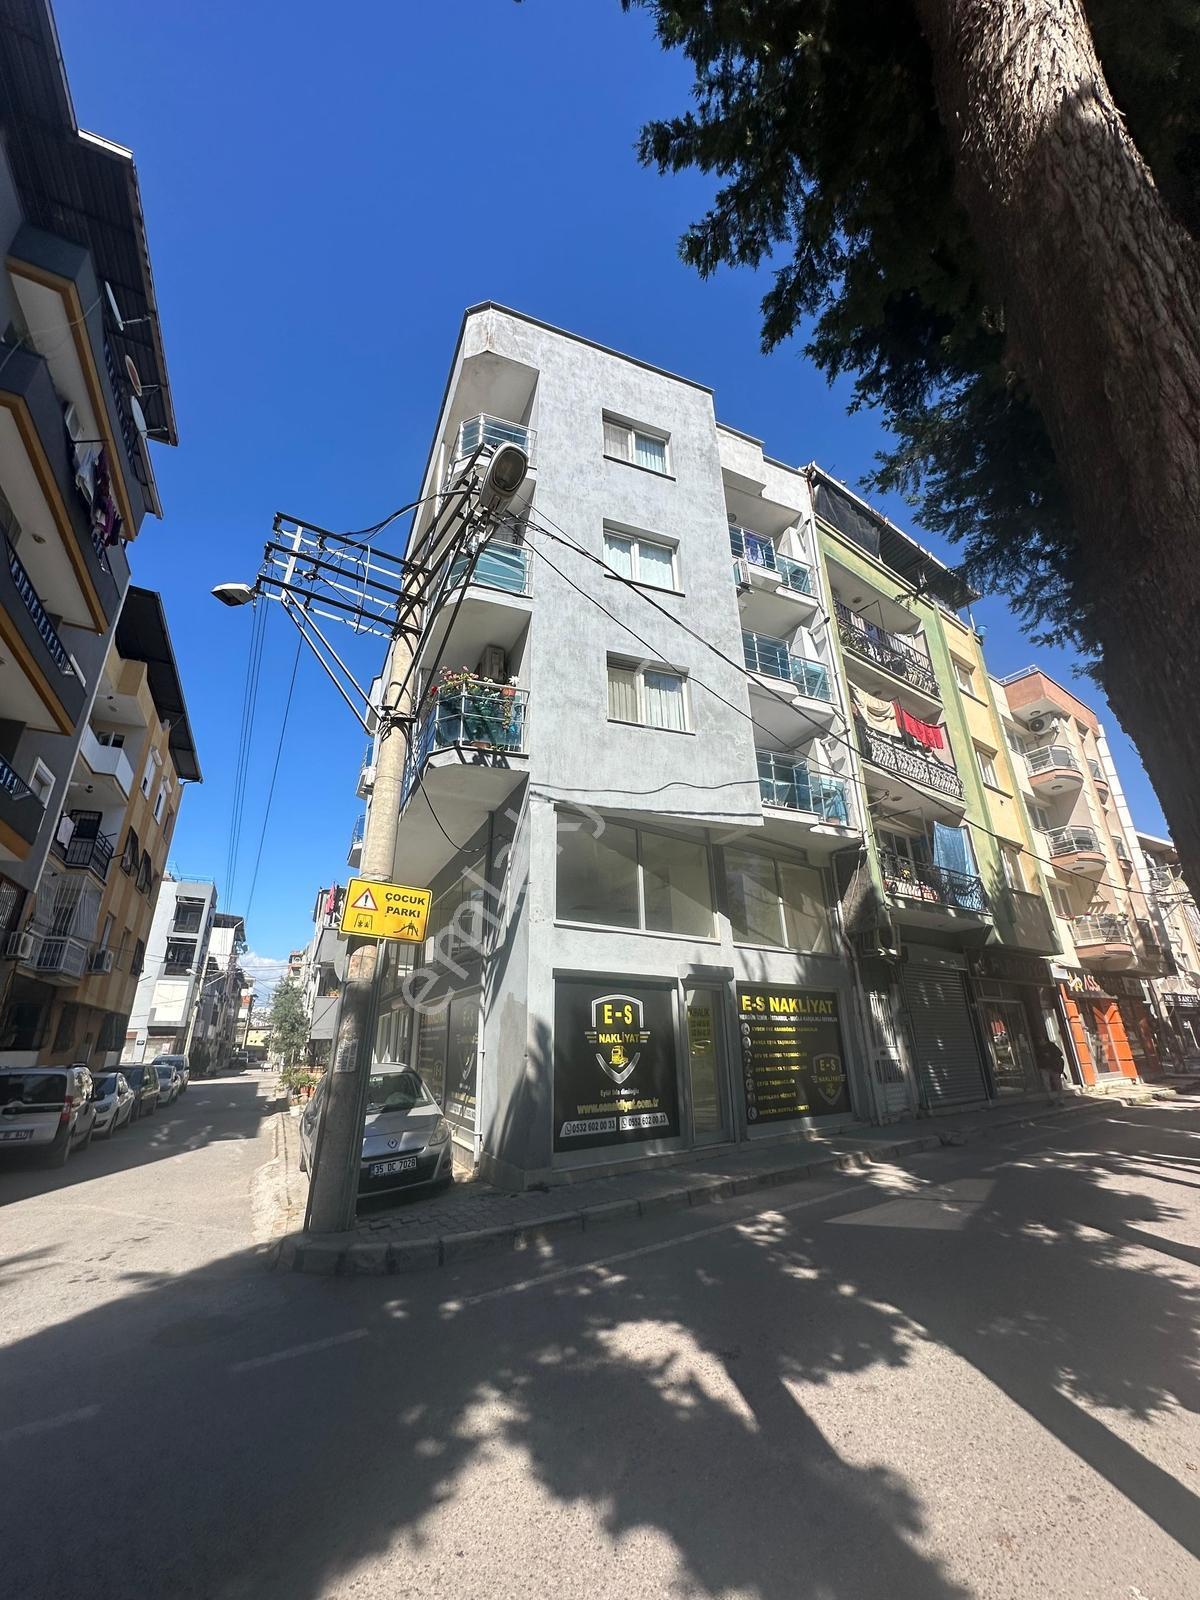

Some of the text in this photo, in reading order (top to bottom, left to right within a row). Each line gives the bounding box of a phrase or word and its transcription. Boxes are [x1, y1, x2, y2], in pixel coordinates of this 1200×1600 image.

[385, 892, 426, 906] ÇOCUK
[386, 906, 420, 918] PARKI
[742, 994, 833, 1014] E-S NAKLİYAT
[598, 1030, 641, 1043] NAKLİYAT
[375, 1165, 384, 1174] 35
